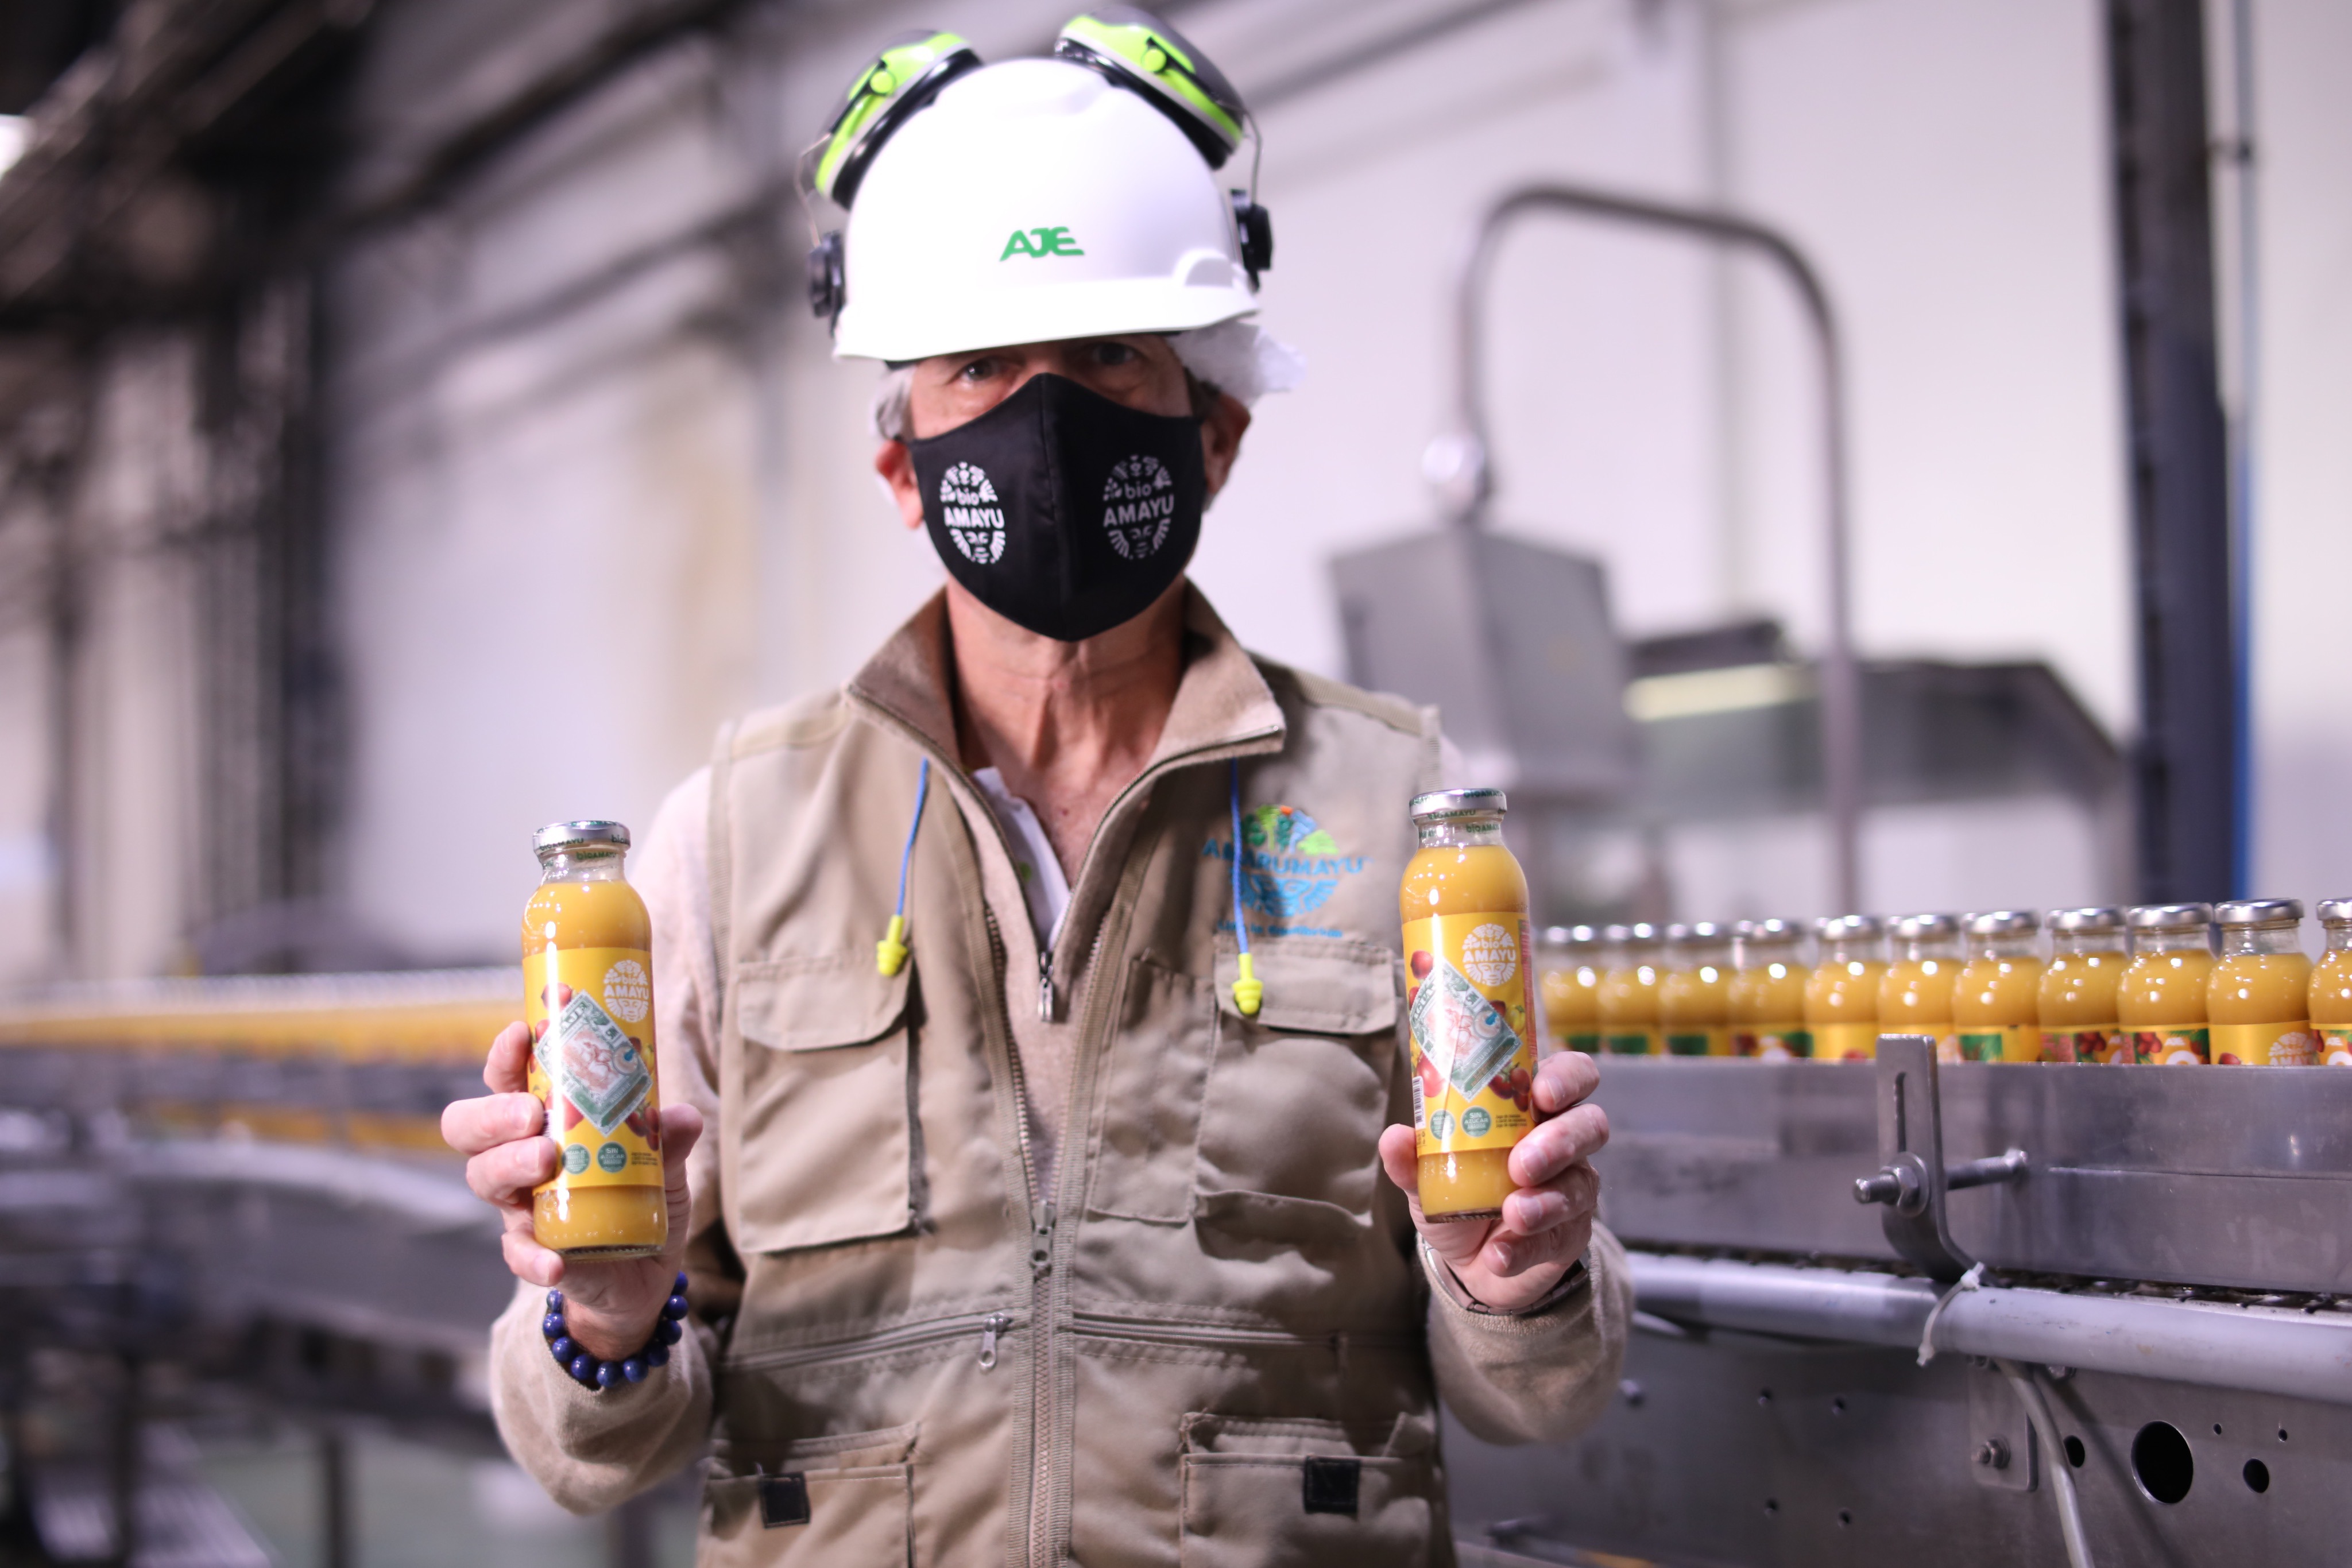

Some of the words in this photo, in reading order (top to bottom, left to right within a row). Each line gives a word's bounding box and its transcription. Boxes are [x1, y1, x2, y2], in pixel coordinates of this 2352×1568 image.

[999, 226, 1084, 262] AJE
[956, 487, 980, 505] bio
[1124, 481, 1151, 499] bio
[943, 506, 1005, 529] AMAYU
[1103, 494, 1174, 528] AMAYU
[1462, 949, 1516, 962] AMAYU
[604, 985, 649, 1000] AMAYU
